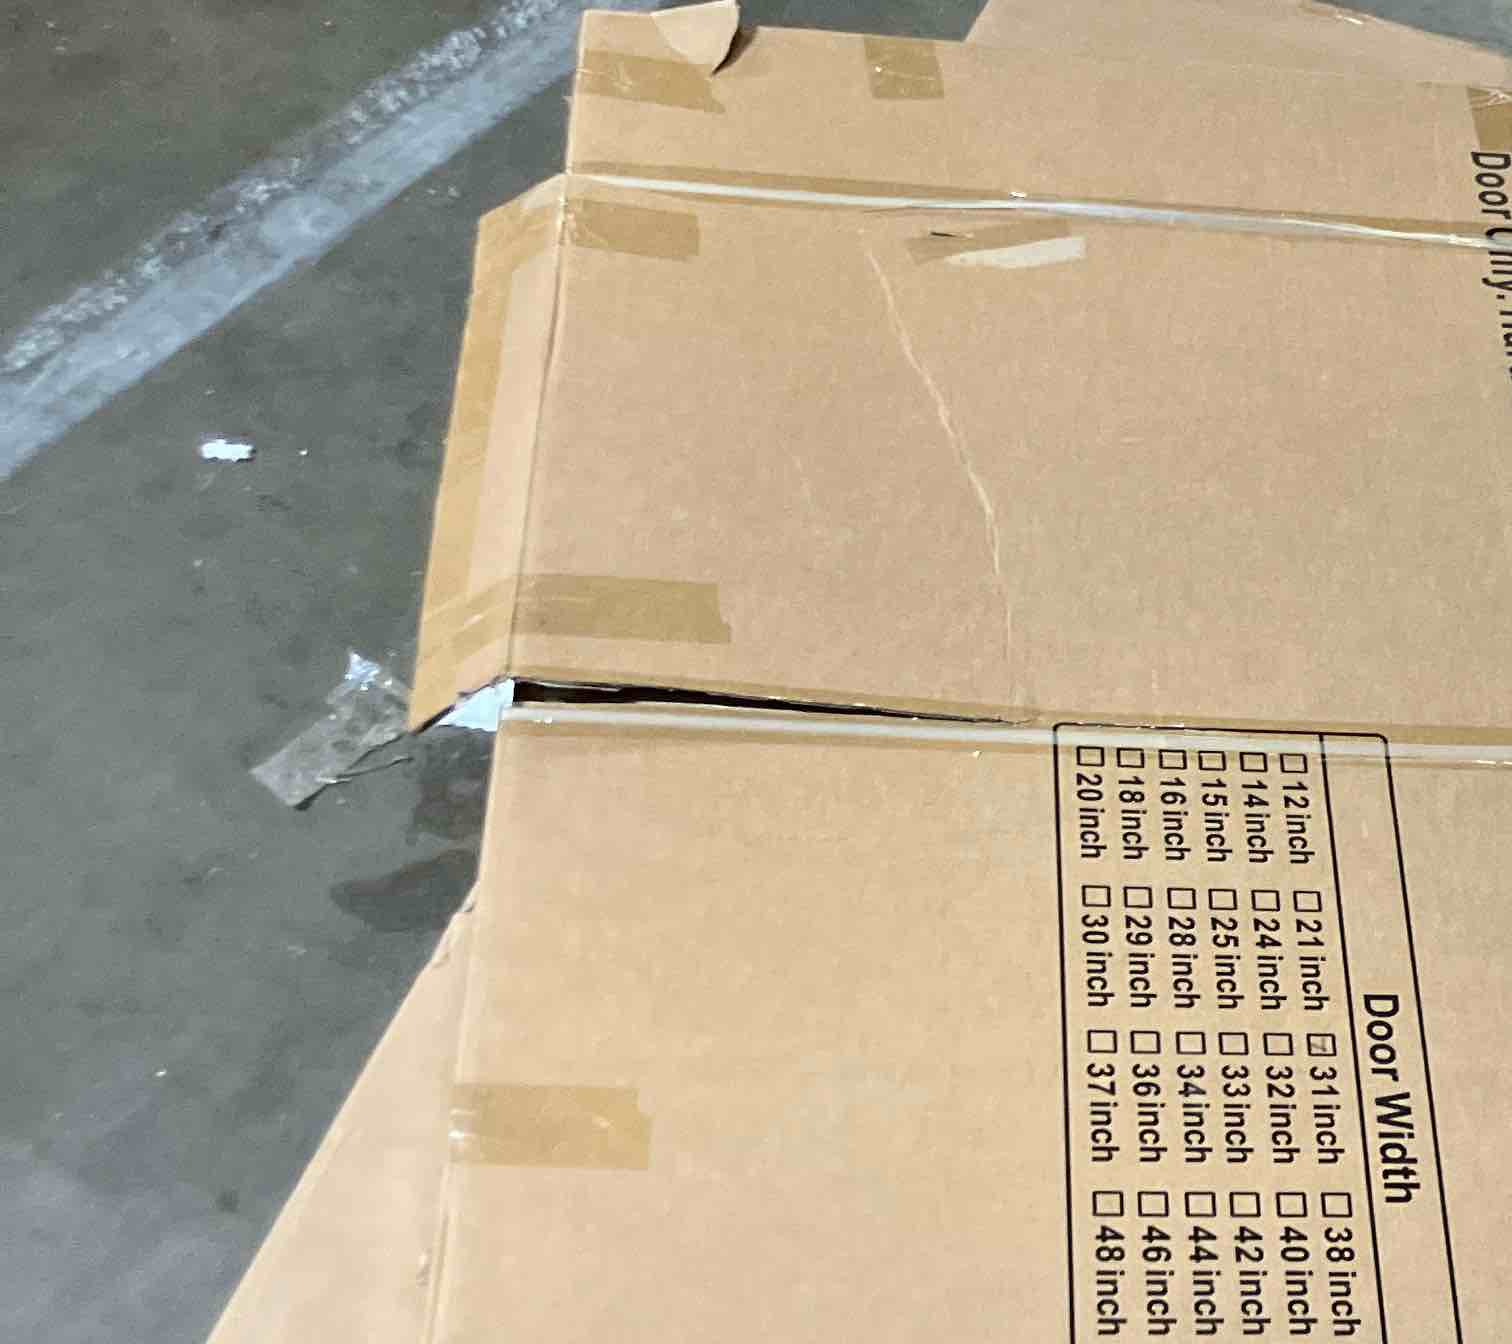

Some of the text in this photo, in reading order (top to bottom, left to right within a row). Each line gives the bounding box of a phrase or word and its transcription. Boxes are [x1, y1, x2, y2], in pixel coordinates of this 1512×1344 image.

[1471, 152, 1511, 220] Door
[1076, 773, 1107, 858] 20 inch
[1118, 776, 1150, 859] 18 inch
[1160, 777, 1191, 861] 16 inch
[1201, 778, 1233, 862] 15 inch
[1241, 780, 1274, 863] 14 inch
[1282, 781, 1315, 864] 12 inch
[1081, 914, 1115, 1007] 30 inch
[1125, 915, 1157, 1008] 29 inch
[1168, 916, 1201, 1008] 28 inch
[1210, 917, 1245, 1009] 25 inch
[1253, 917, 1287, 1010] 24 inch
[1296, 919, 1330, 1010] 21 inch
[1086, 1063, 1120, 1162] 37 inch
[1132, 1064, 1168, 1162] 36 inch
[1176, 1064, 1213, 1163] 34 inch
[1221, 1065, 1254, 1163] 33 inch
[1266, 1065, 1301, 1163] 32 inch
[1309, 1066, 1345, 1164] 31 inch
[1363, 994, 1421, 1204] Door Width
[1095, 1225, 1128, 1336] 48 inch
[1142, 1225, 1177, 1335] 46 inch
[1188, 1226, 1224, 1336] 44 inch
[1234, 1226, 1271, 1335] 42 inch
[1280, 1226, 1318, 1335] 40 inch
[1324, 1227, 1361, 1336] 38 inch
